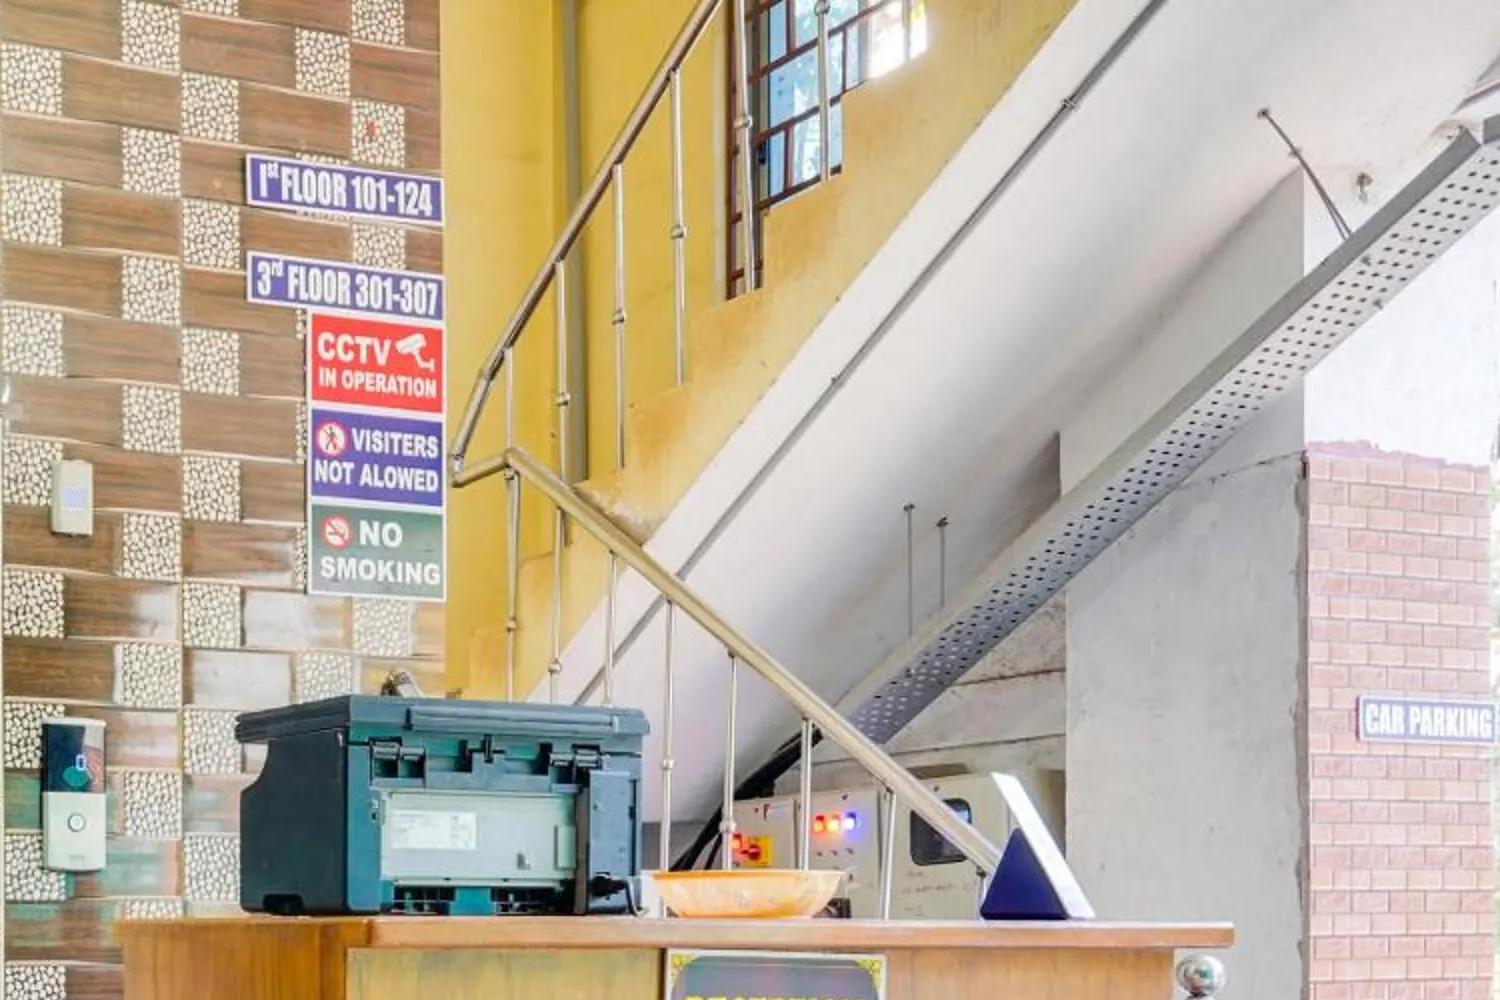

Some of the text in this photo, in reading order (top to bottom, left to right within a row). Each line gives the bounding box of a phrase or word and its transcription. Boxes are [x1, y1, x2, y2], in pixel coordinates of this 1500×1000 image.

[281, 166, 347, 208] FLOOR
[351, 175, 433, 217] 101-124
[257, 261, 439, 316] 3rd FLOOR 301-307
[317, 332, 392, 366] CCTV
[319, 367, 437, 399] IN OPERATION
[351, 427, 439, 459] VISITERS
[315, 459, 439, 493] NOT ALOWED
[359, 520, 403, 548] NO
[320, 556, 441, 586] SMOKING
[1366, 703, 1493, 738] CAR PARKING
